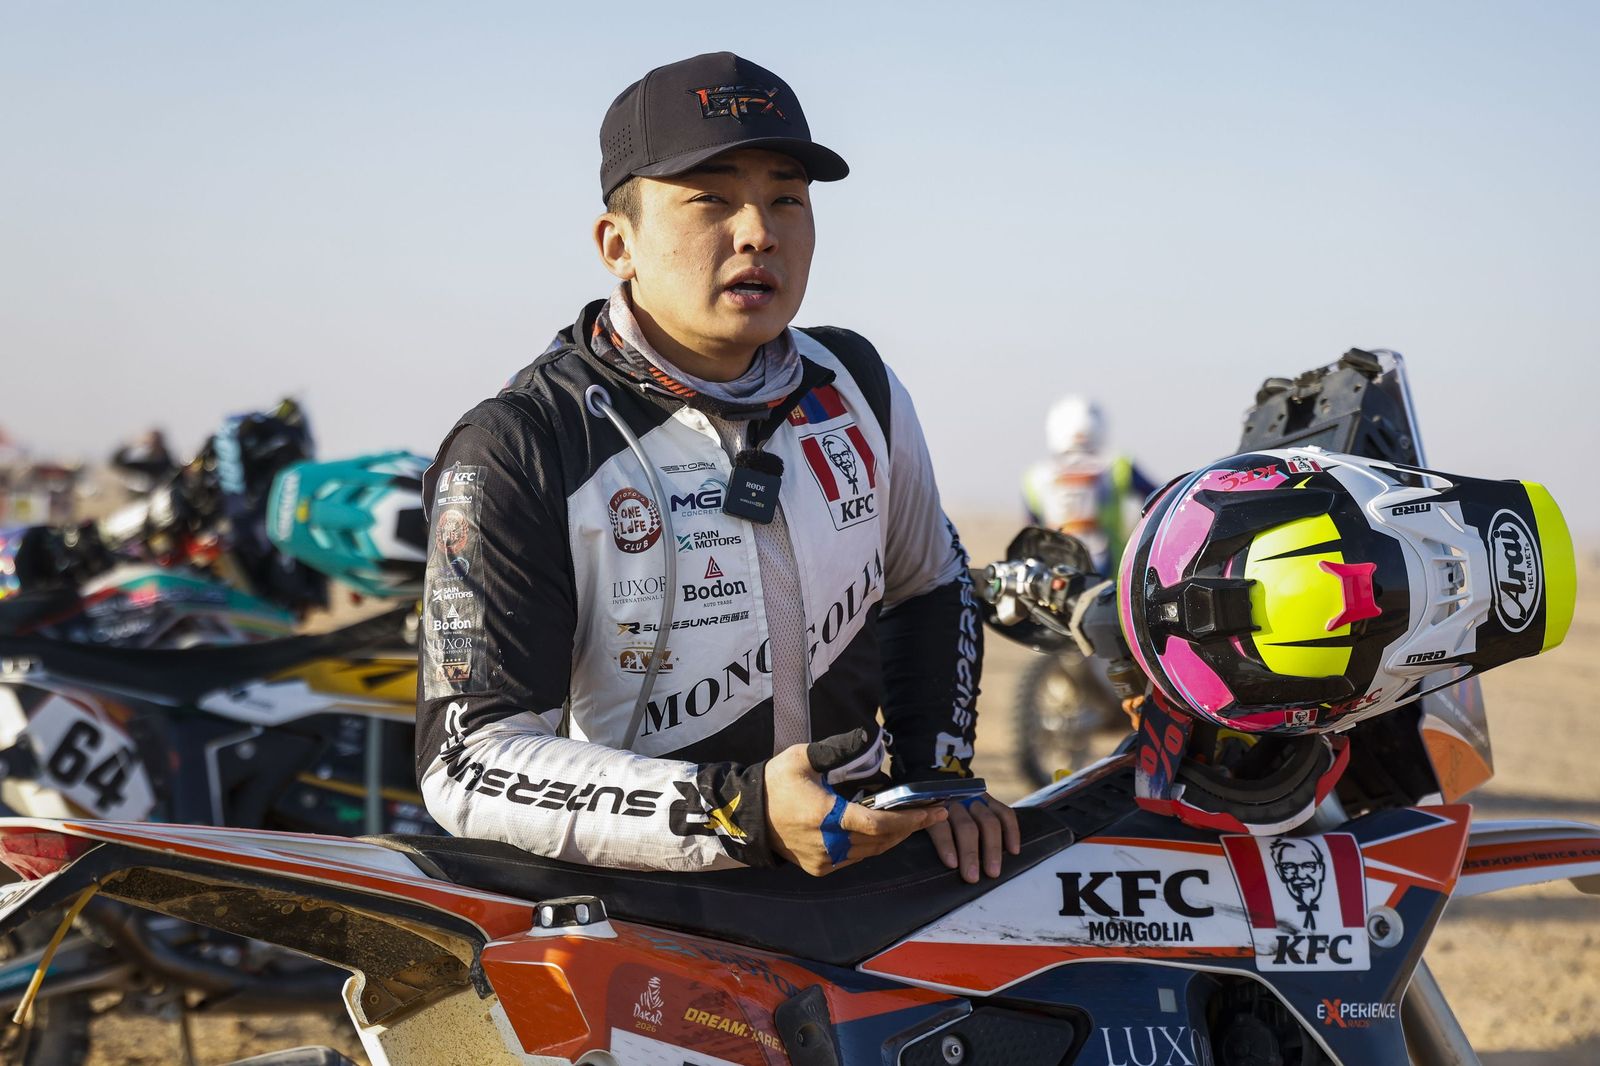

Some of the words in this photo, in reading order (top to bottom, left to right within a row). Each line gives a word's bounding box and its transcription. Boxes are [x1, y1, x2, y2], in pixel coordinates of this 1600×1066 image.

[453, 472, 476, 481] KFC
[1221, 464, 1279, 491] KFC
[670, 489, 721, 512] MG
[841, 493, 875, 523] KFC
[1392, 503, 1431, 517] MRD
[621, 506, 642, 519] ONE
[624, 540, 649, 551] CLUB
[693, 530, 719, 541] SAIN
[694, 535, 742, 550] MOTORS
[1493, 525, 1528, 621] Arai
[1524, 545, 1535, 590] HELMET
[443, 591, 473, 600] MOTORS
[682, 579, 748, 602] Bodon
[433, 618, 472, 631] Bodon
[1406, 650, 1447, 664] MRD
[49, 720, 127, 812] 64
[1056, 869, 1215, 918] KFC
[1088, 921, 1194, 941] MONGOLIA
[1272, 934, 1353, 965] KFC
[633, 1002, 664, 1026] DAKAR
[683, 1007, 748, 1037] DREAM.
[1317, 998, 1396, 1028] EXPERIENCE
[634, 1020, 657, 1033] 2026
